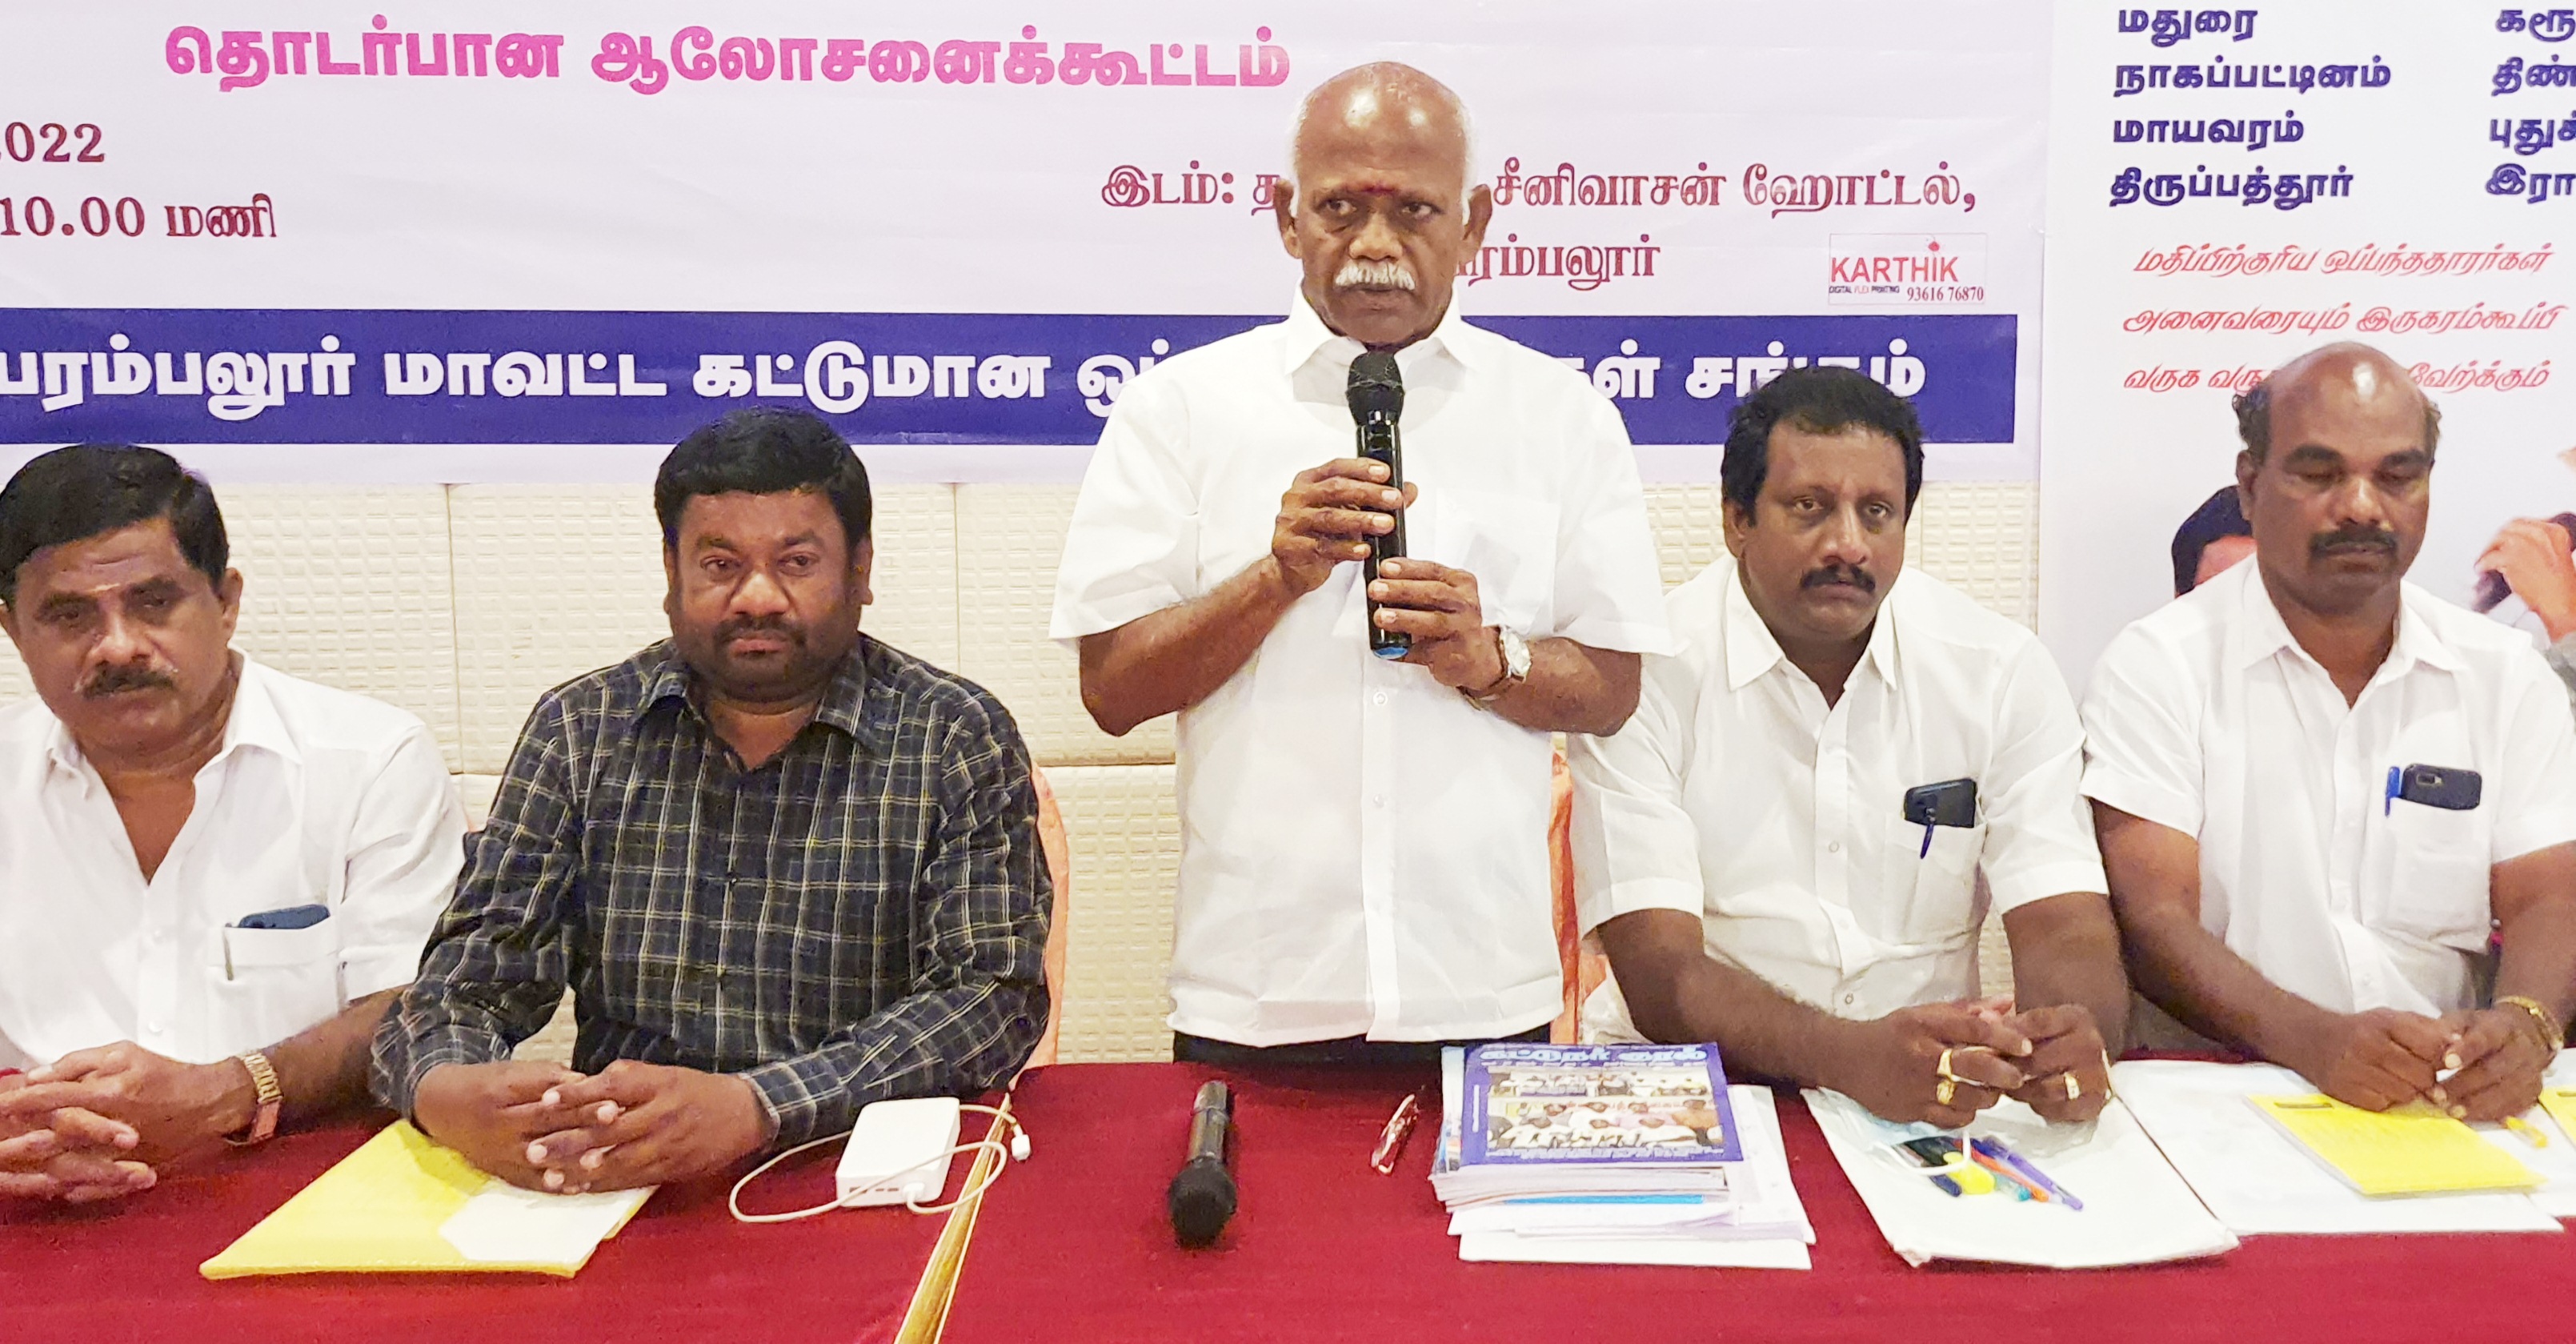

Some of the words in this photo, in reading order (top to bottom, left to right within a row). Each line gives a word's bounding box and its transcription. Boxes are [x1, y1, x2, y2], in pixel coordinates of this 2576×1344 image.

[2117, 9, 2259, 48] மதுரை
[165, 14, 564, 93] தொடர்பான
[591, 24, 1291, 96] ஆலோசனைக்கூட்டம்
[2113, 54, 2392, 98] நாகப்பட்டினம்
[0, 122, 106, 163] 022
[2113, 109, 2305, 152] மாயவரம்
[1100, 159, 1235, 208] இடம்:
[1492, 156, 1728, 207] சீனிவாசன்
[1742, 160, 1976, 219] ஹோட்டல்,
[2109, 164, 2354, 211] திருப்பத்தூர்
[0, 195, 146, 238] 10.00
[163, 192, 278, 239] மணி
[1831, 256, 1958, 283] KARTHIK
[2133, 243, 2321, 278] மதிப்பிற்குரிய
[2321, 242, 2555, 276] ஒப்பந்ததாரர்கள்
[1907, 287, 1944, 301] 93616
[1948, 286, 1984, 301] 76870
[2122, 301, 2351, 336] அனைவரையும்
[2356, 301, 2570, 335] இருகரம்கூப்பி
[383, 351, 667, 397] மாவட்ட
[692, 340, 1052, 414] கட்டுமான
[1685, 338, 1926, 399] சங்ம்
[2123, 363, 2201, 393] வருக
[2207, 363, 2282, 394] வரு
